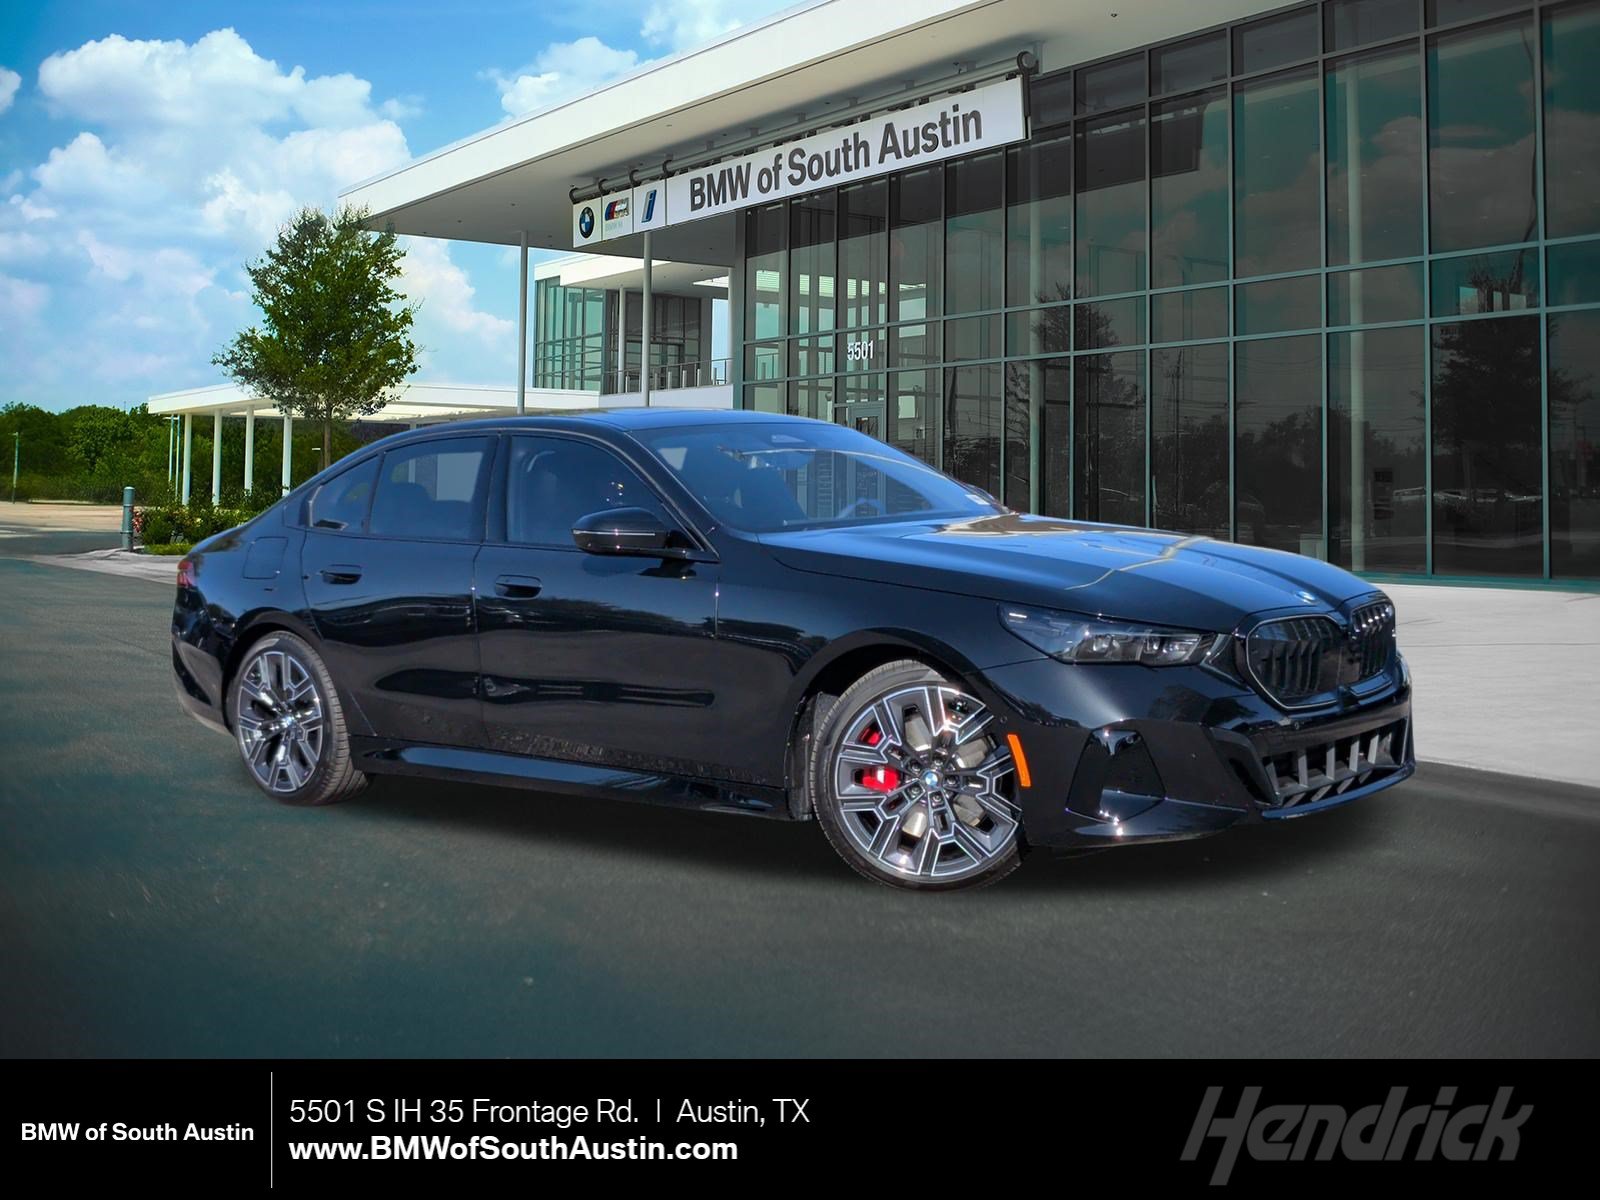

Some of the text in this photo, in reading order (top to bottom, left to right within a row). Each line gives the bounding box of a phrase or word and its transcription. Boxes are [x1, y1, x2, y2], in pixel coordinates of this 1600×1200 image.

[690, 104, 982, 211] BMW of South Austin
[847, 340, 873, 361] 5501
